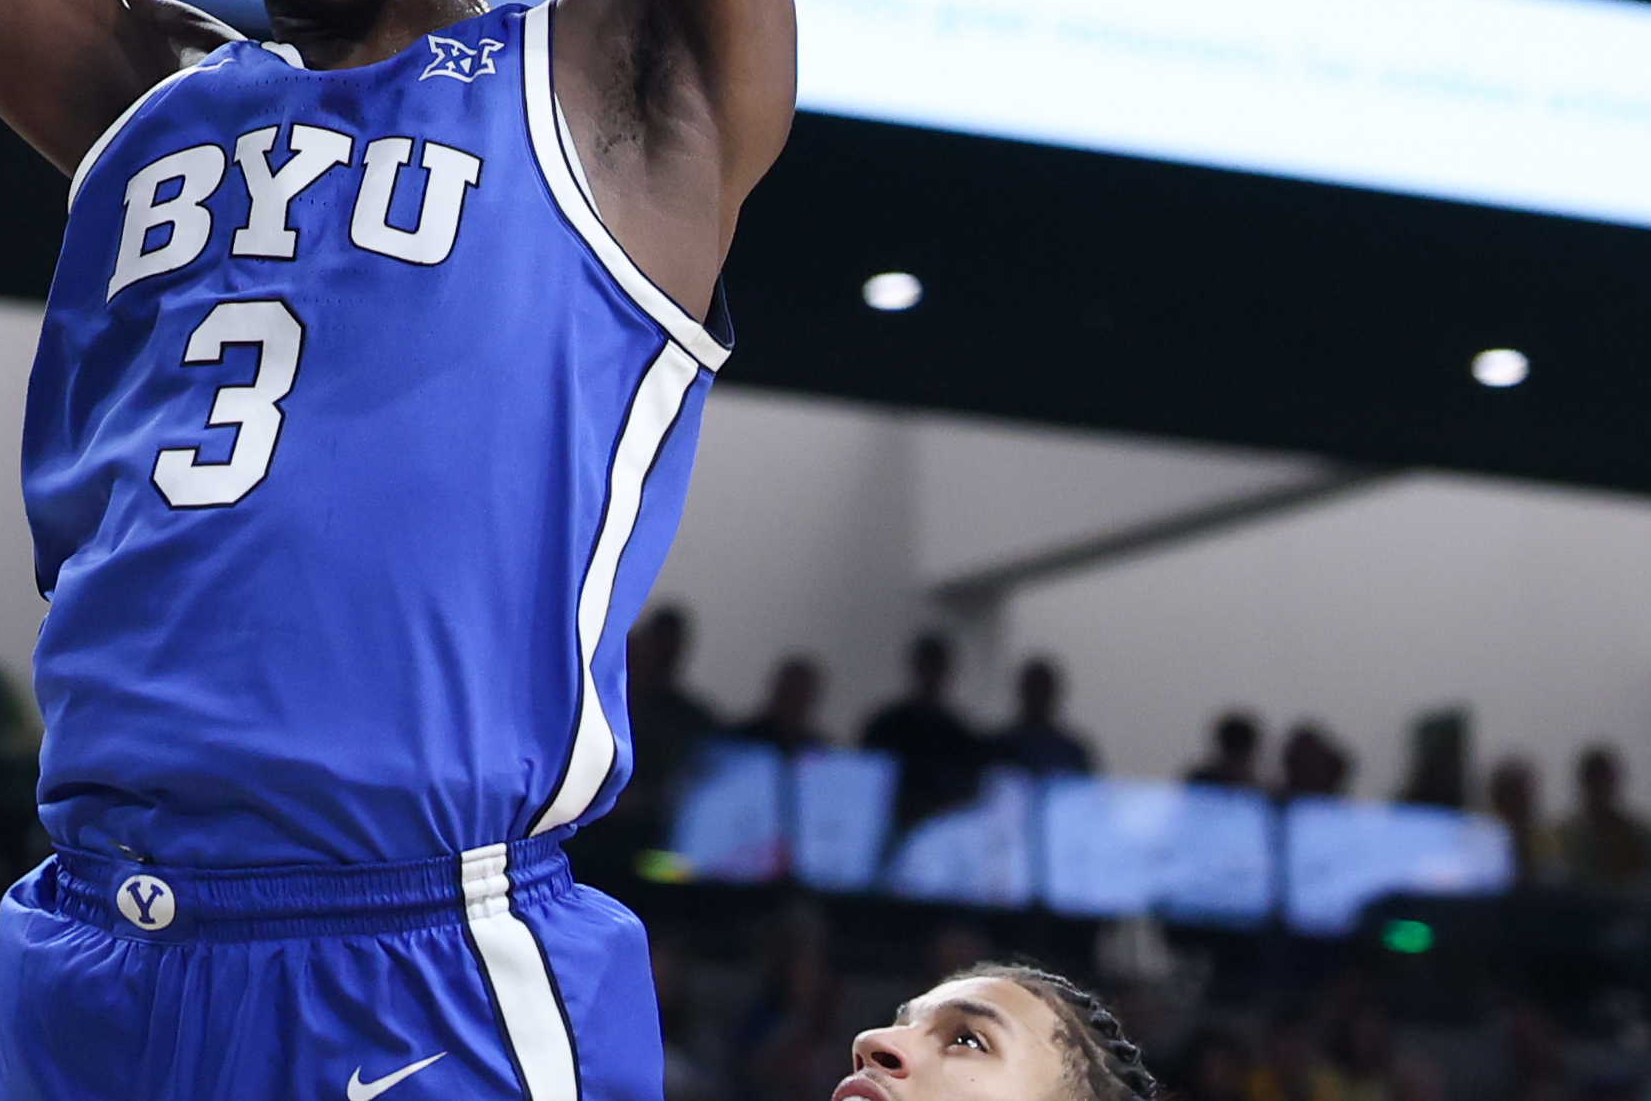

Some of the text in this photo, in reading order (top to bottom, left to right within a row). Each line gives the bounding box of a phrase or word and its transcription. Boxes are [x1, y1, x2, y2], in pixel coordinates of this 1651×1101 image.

[105, 122, 484, 304] BYU
[151, 298, 306, 511] 3
[125, 880, 165, 925] Y
